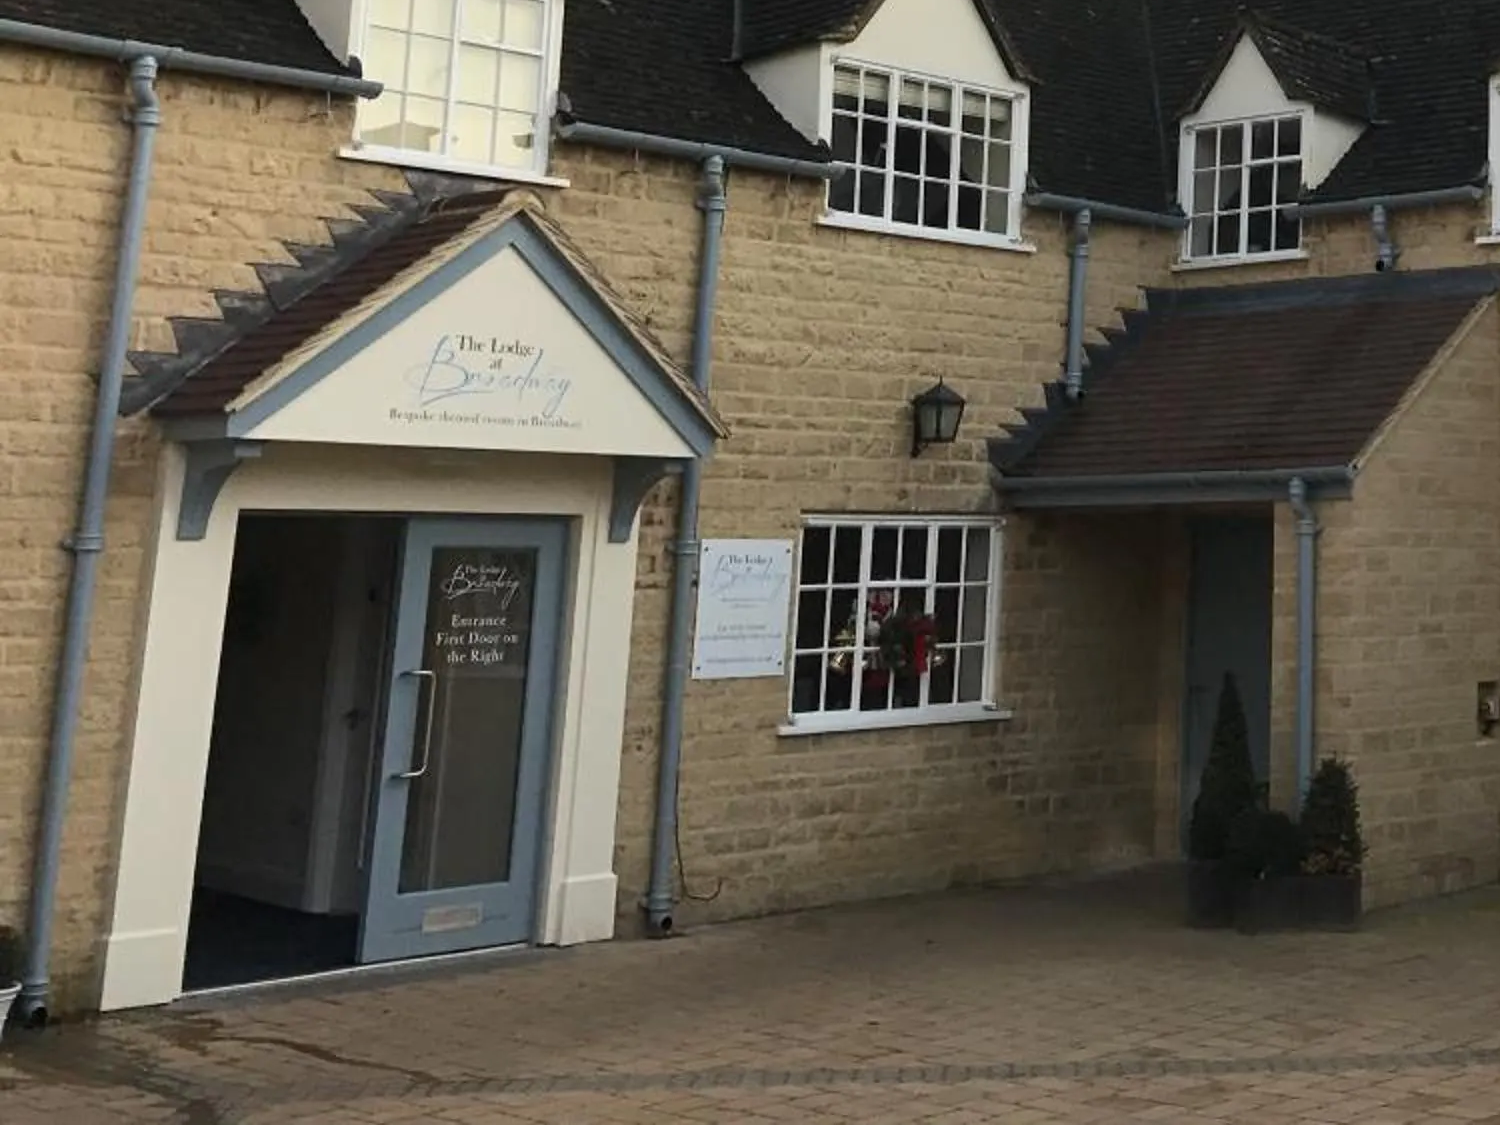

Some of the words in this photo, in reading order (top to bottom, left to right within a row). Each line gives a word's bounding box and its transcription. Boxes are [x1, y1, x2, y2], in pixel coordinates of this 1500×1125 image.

[456, 334, 486, 352] The
[490, 336, 537, 357] Lodge
[451, 614, 507, 628] Entrance
[436, 632, 465, 646] First
[468, 632, 499, 645] Door
[447, 650, 467, 664] the
[470, 648, 503, 665] Right
